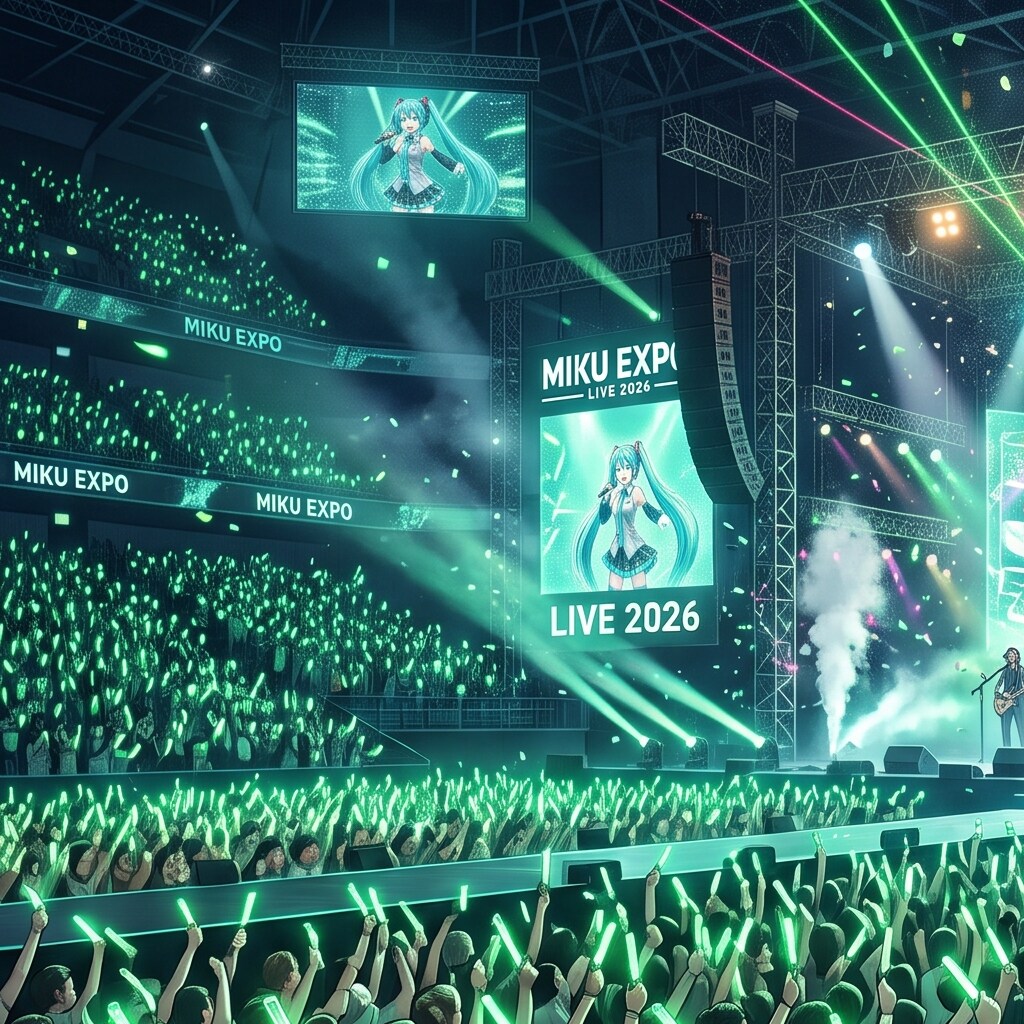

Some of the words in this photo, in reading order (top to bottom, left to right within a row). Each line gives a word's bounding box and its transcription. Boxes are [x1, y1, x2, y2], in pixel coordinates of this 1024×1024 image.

[184, 316, 231, 343] MIKU
[235, 328, 282, 353] EXPO
[542, 349, 608, 390] MIKU
[588, 384, 616, 400] LIVE
[619, 380, 651, 396] 2026
[14, 460, 68, 487] MIKU
[75, 468, 129, 494] EXPO
[256, 492, 301, 515] MIKU
[306, 498, 353, 521] EXPO
[551, 603, 616, 637] LIVE
[624, 600, 700, 634] 2026
